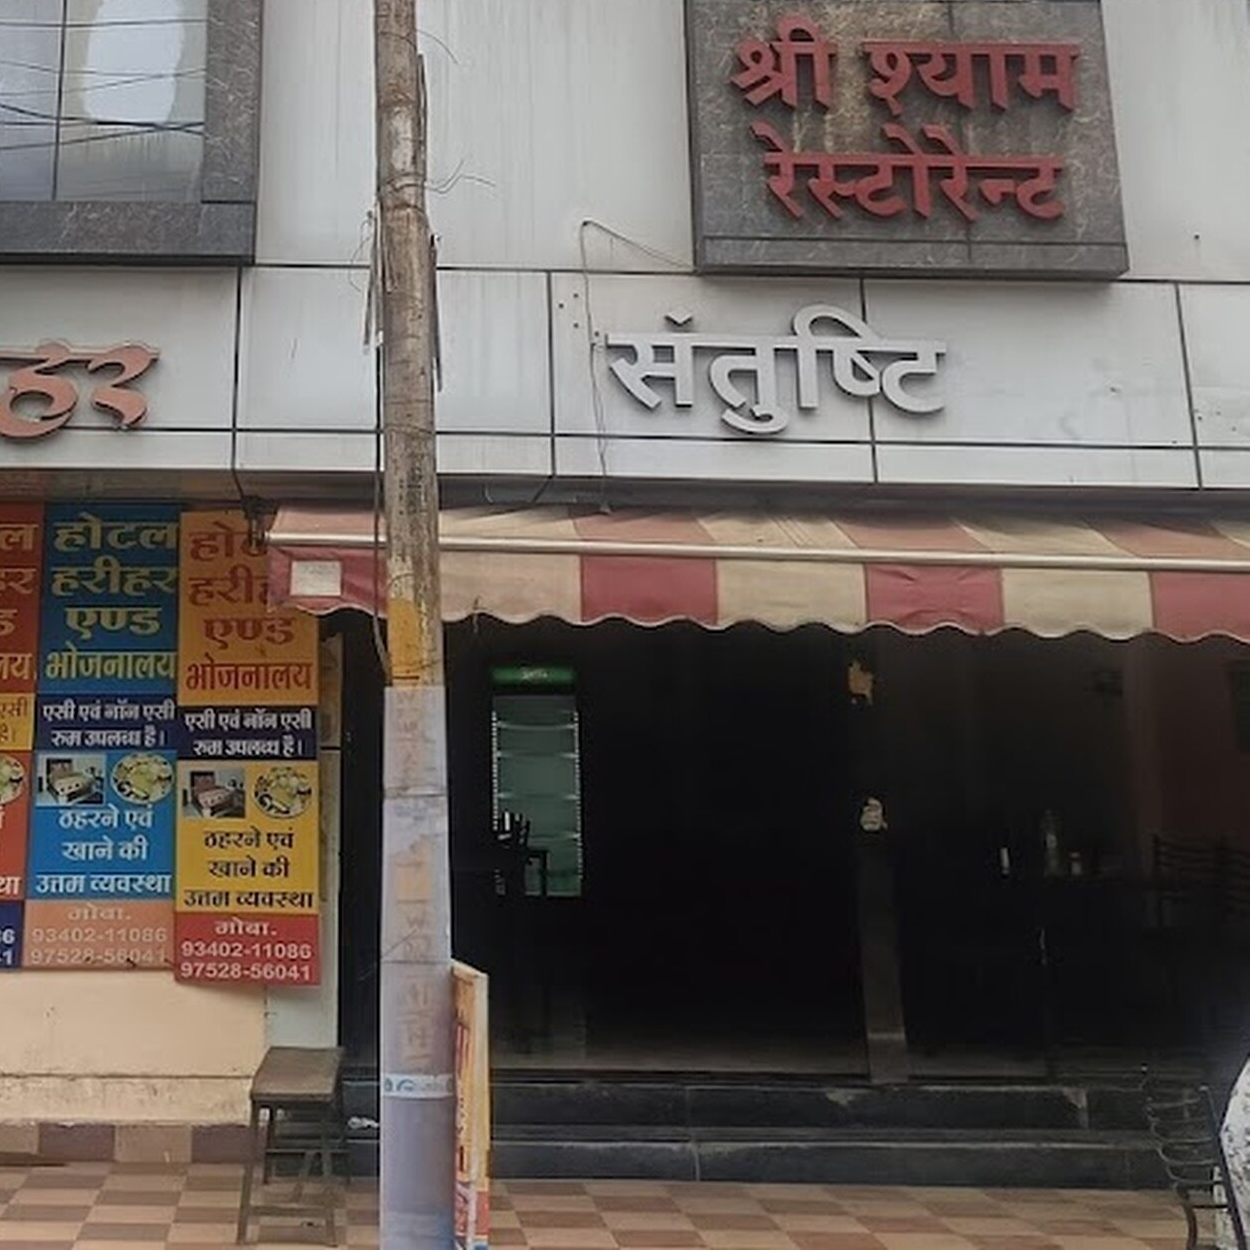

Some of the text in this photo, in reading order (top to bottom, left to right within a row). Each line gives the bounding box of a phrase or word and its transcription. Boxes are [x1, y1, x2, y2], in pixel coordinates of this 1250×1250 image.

[730, 14, 1082, 116] श्री श्याम
[751, 121, 1065, 223] रेस्टोरेन्ट
[605, 304, 948, 435] संतुष्टि
[52, 511, 180, 551] होटल
[51, 554, 177, 596] हरीहर
[65, 606, 163, 639] एण्ड
[204, 616, 297, 649] एण्ड
[45, 640, 178, 680] भोजनालय
[186, 651, 313, 690] भोजनालय
[59, 803, 118, 829] ठहरने
[62, 835, 148, 861] खाने की
[204, 826, 261, 849] ठहरने
[209, 855, 290, 878] खाने की
[90, 873, 172, 893] व्यवस्था
[235, 890, 313, 908] व्यवस्था
[31, 927, 167, 943] 93402-11086
[30, 948, 165, 964] 97528-56041
[181, 941, 312, 959] 93402-11086
[181, 962, 310, 981] 97528-56041
